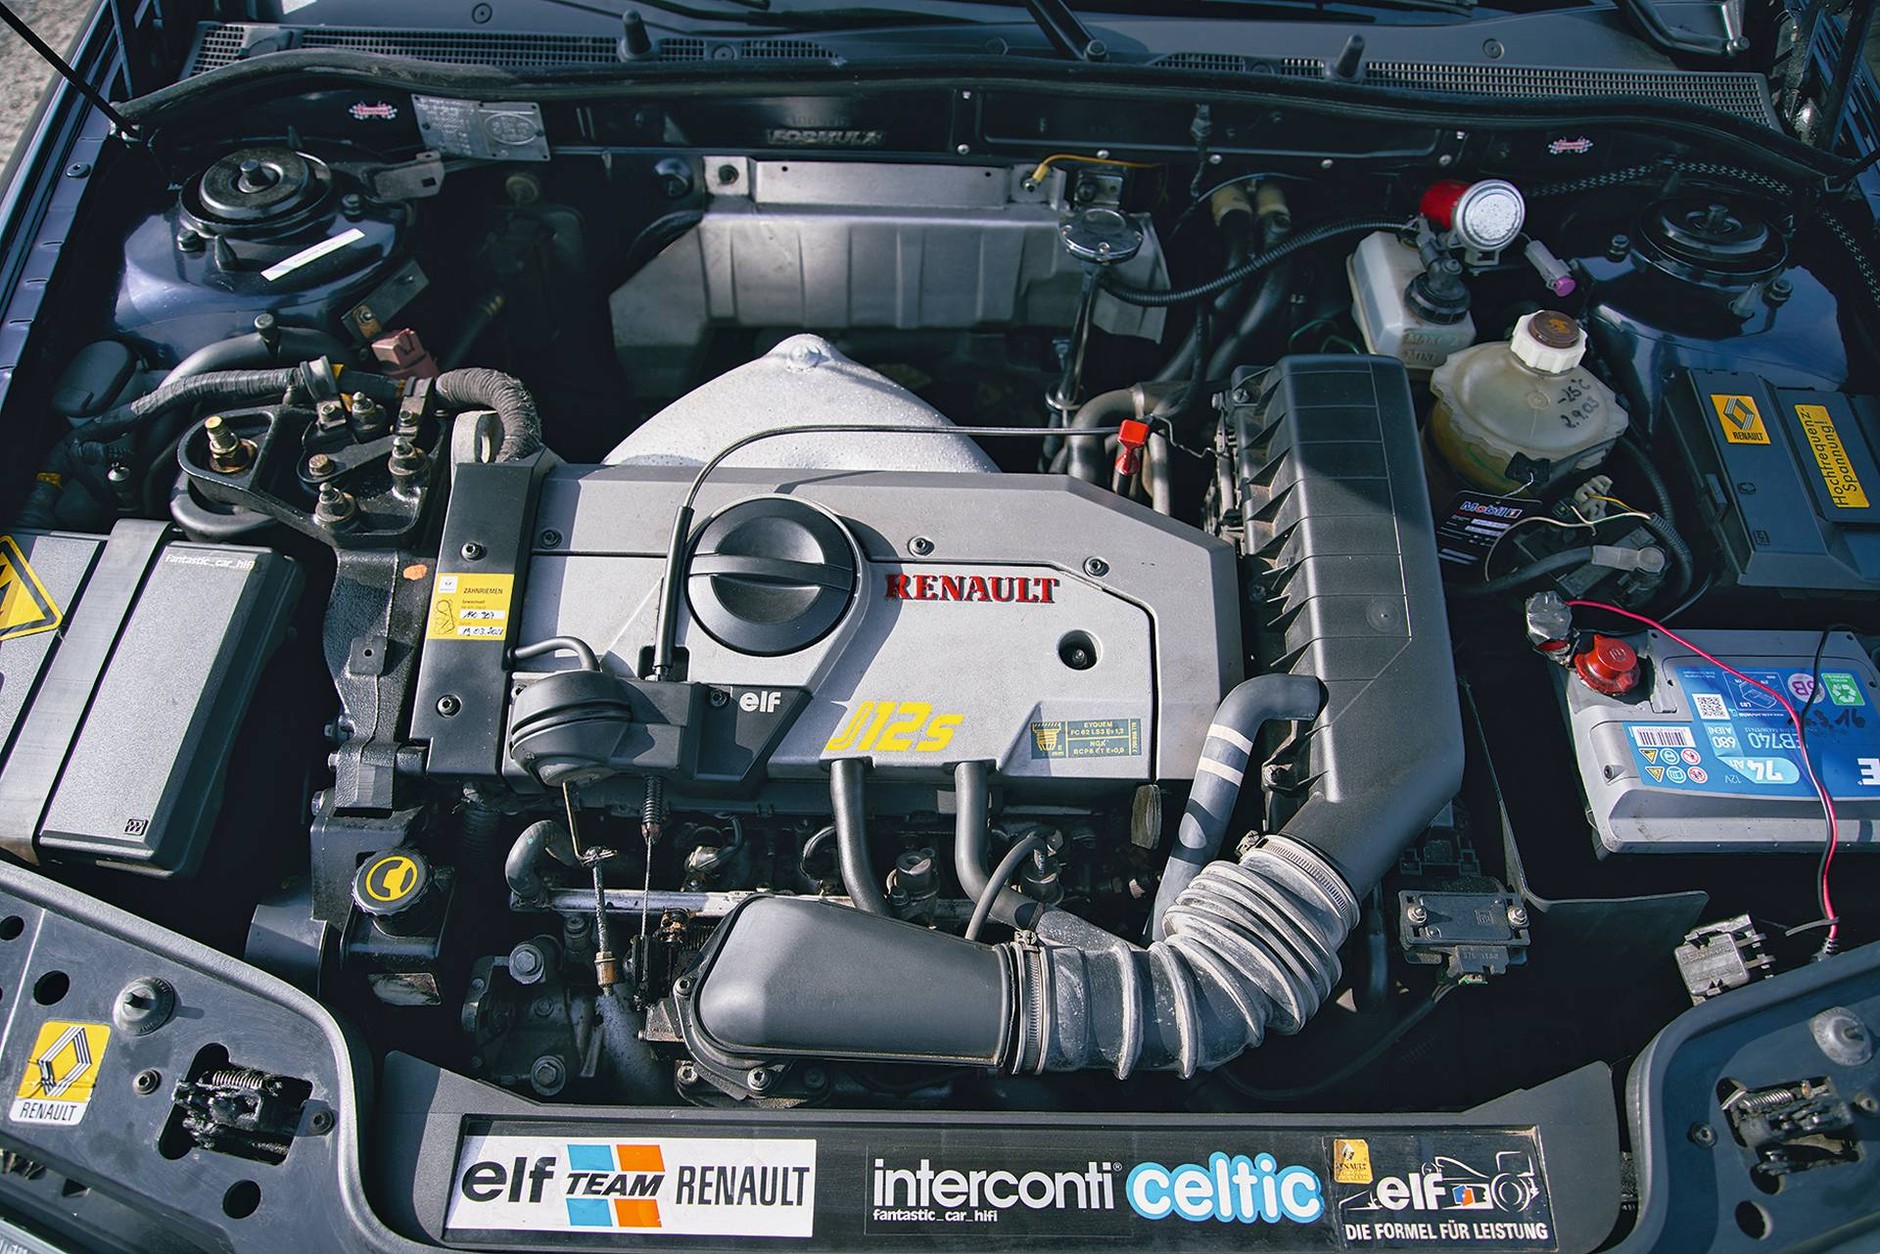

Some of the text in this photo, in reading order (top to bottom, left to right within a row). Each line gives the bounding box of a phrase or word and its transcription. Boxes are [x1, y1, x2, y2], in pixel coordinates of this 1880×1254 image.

[1732, 431, 1764, 441] RENAULT
[1801, 408, 1849, 506] Hochfrequenz-
[1814, 420, 1858, 492] Spannung!
[1460, 500, 1507, 517] Mobil
[165, 554, 255, 571] fantastic_car_hifi
[463, 587, 504, 595] ZAHNRIEMEN
[885, 573, 1061, 604] RENAULT
[739, 691, 781, 713] elf
[1712, 736, 1736, 749] 680
[1746, 759, 1785, 783] 74
[19, 1101, 77, 1121] RENAULT
[461, 1156, 811, 1207] elf TEAM RENAULT
[1131, 1155, 1322, 1220] celtic
[1376, 1172, 1446, 1211] elf
[872, 1208, 998, 1223] fantastic_car_hifi
[1345, 1220, 1549, 1241] DIE FORMEL FÜR LEISTUNG
